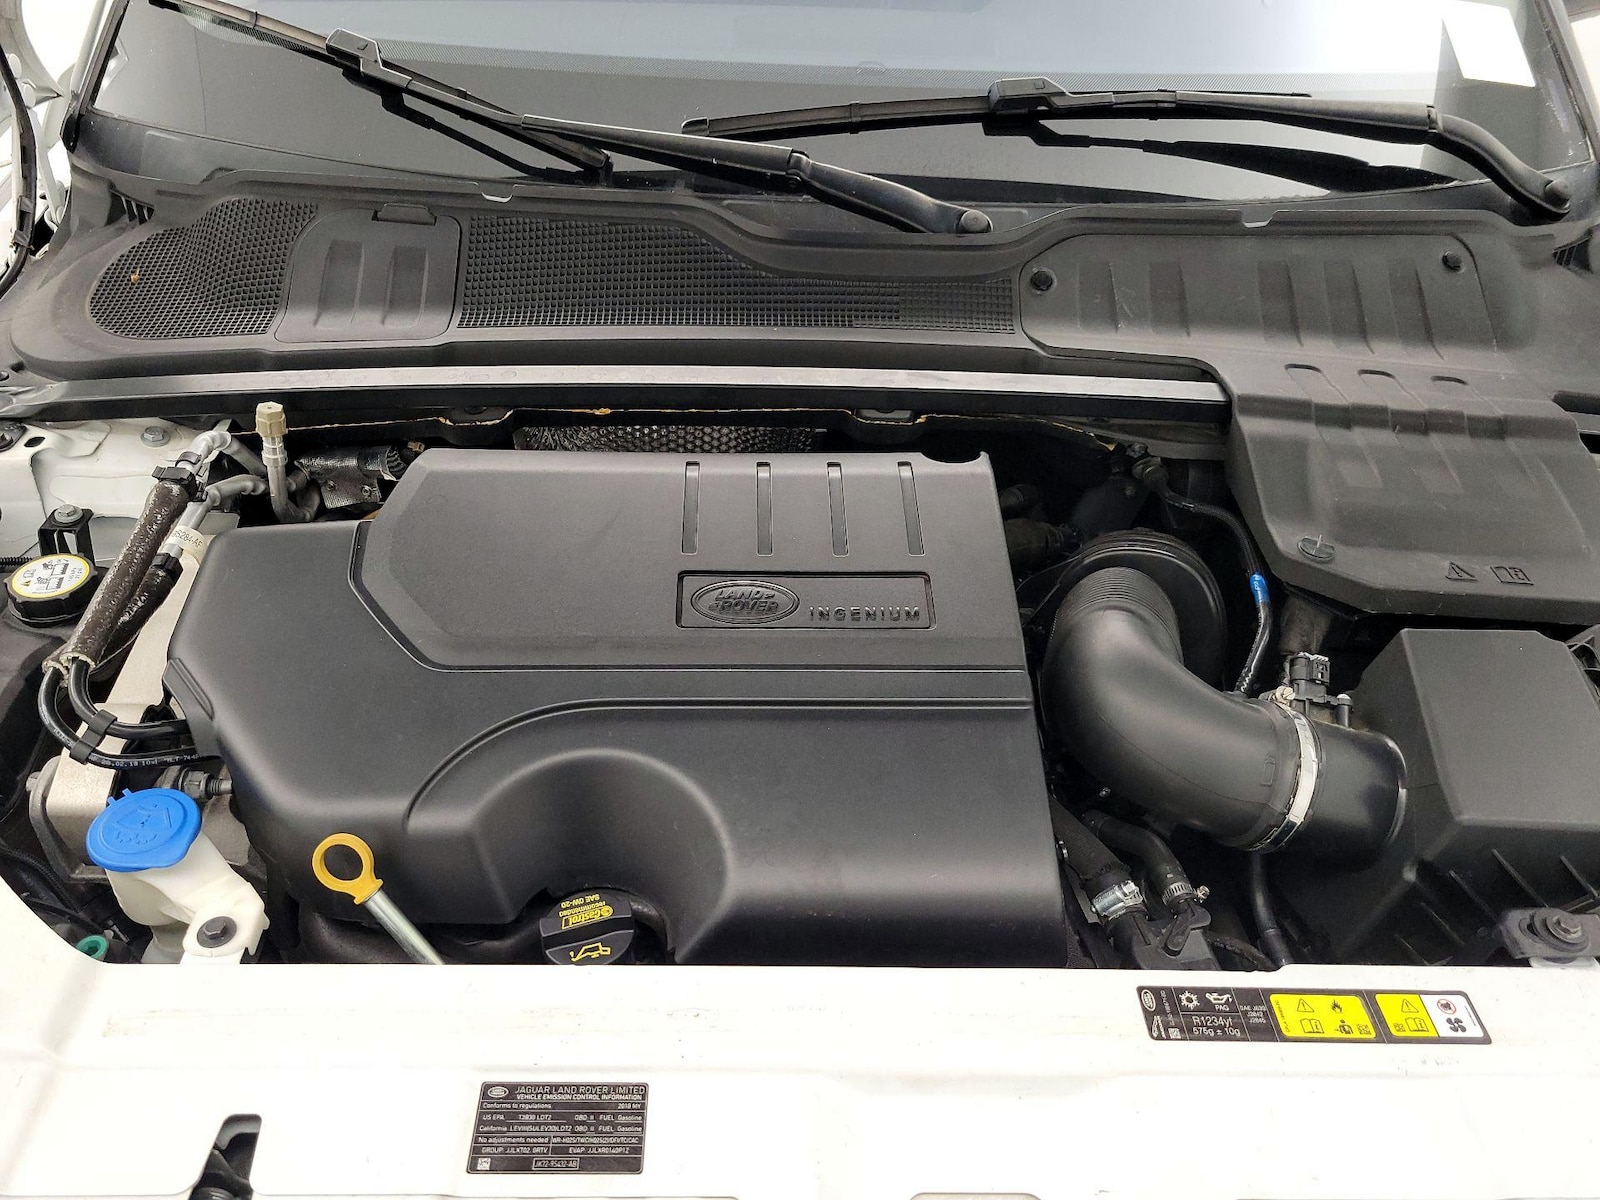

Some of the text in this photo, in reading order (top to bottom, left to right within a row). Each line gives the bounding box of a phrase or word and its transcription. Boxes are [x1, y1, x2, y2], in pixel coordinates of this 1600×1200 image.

[714, 587, 766, 600] LAND
[719, 599, 779, 614] ROVER
[809, 606, 921, 622] INGENIUM
[561, 893, 600, 909] SAE 0W-20
[558, 901, 605, 917] recommended
[568, 909, 601, 925] Castrol
[1192, 1016, 1233, 1027] R1234yf
[1224, 1027, 1241, 1037] 10g
[514, 1086, 550, 1094] JAGUAR
[552, 1086, 577, 1094] LAND
[579, 1086, 608, 1094] ROVER
[611, 1086, 645, 1095] LIMITED
[519, 1102, 552, 1110] regulations
